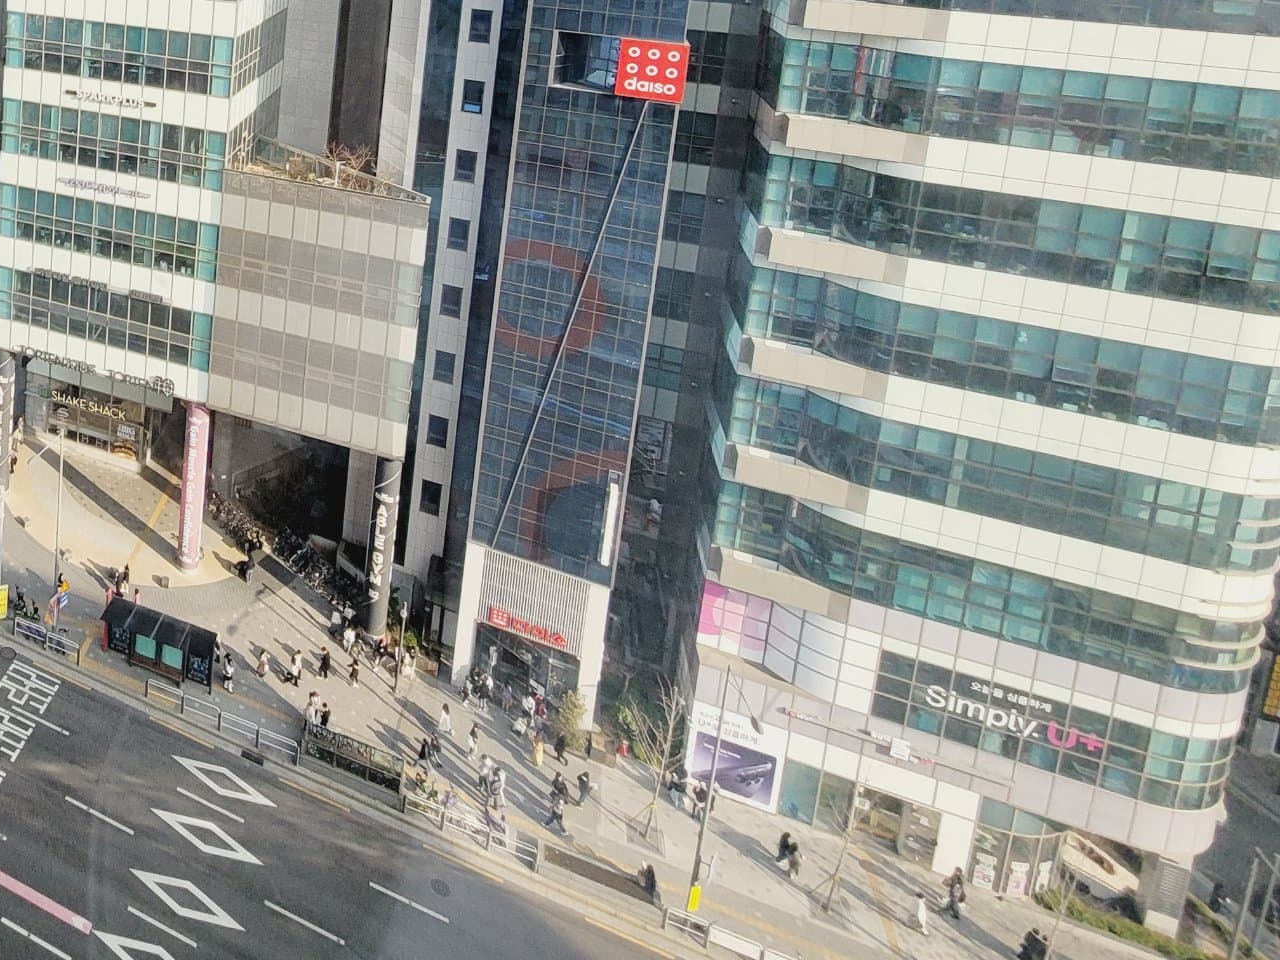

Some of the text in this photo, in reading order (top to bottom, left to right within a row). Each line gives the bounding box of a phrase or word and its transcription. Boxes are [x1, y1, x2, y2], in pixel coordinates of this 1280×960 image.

[624, 77, 676, 95] daiso
[52, 391, 126, 421] SHAKE SHACK
[187, 426, 200, 447] Gain
[182, 504, 195, 554] Confidence
[368, 505, 390, 587] ABLE GYM
[512, 617, 567, 647] 다이소
[970, 682, 1052, 713] 오늘을 심플하게
[1047, 720, 1105, 752] U+
